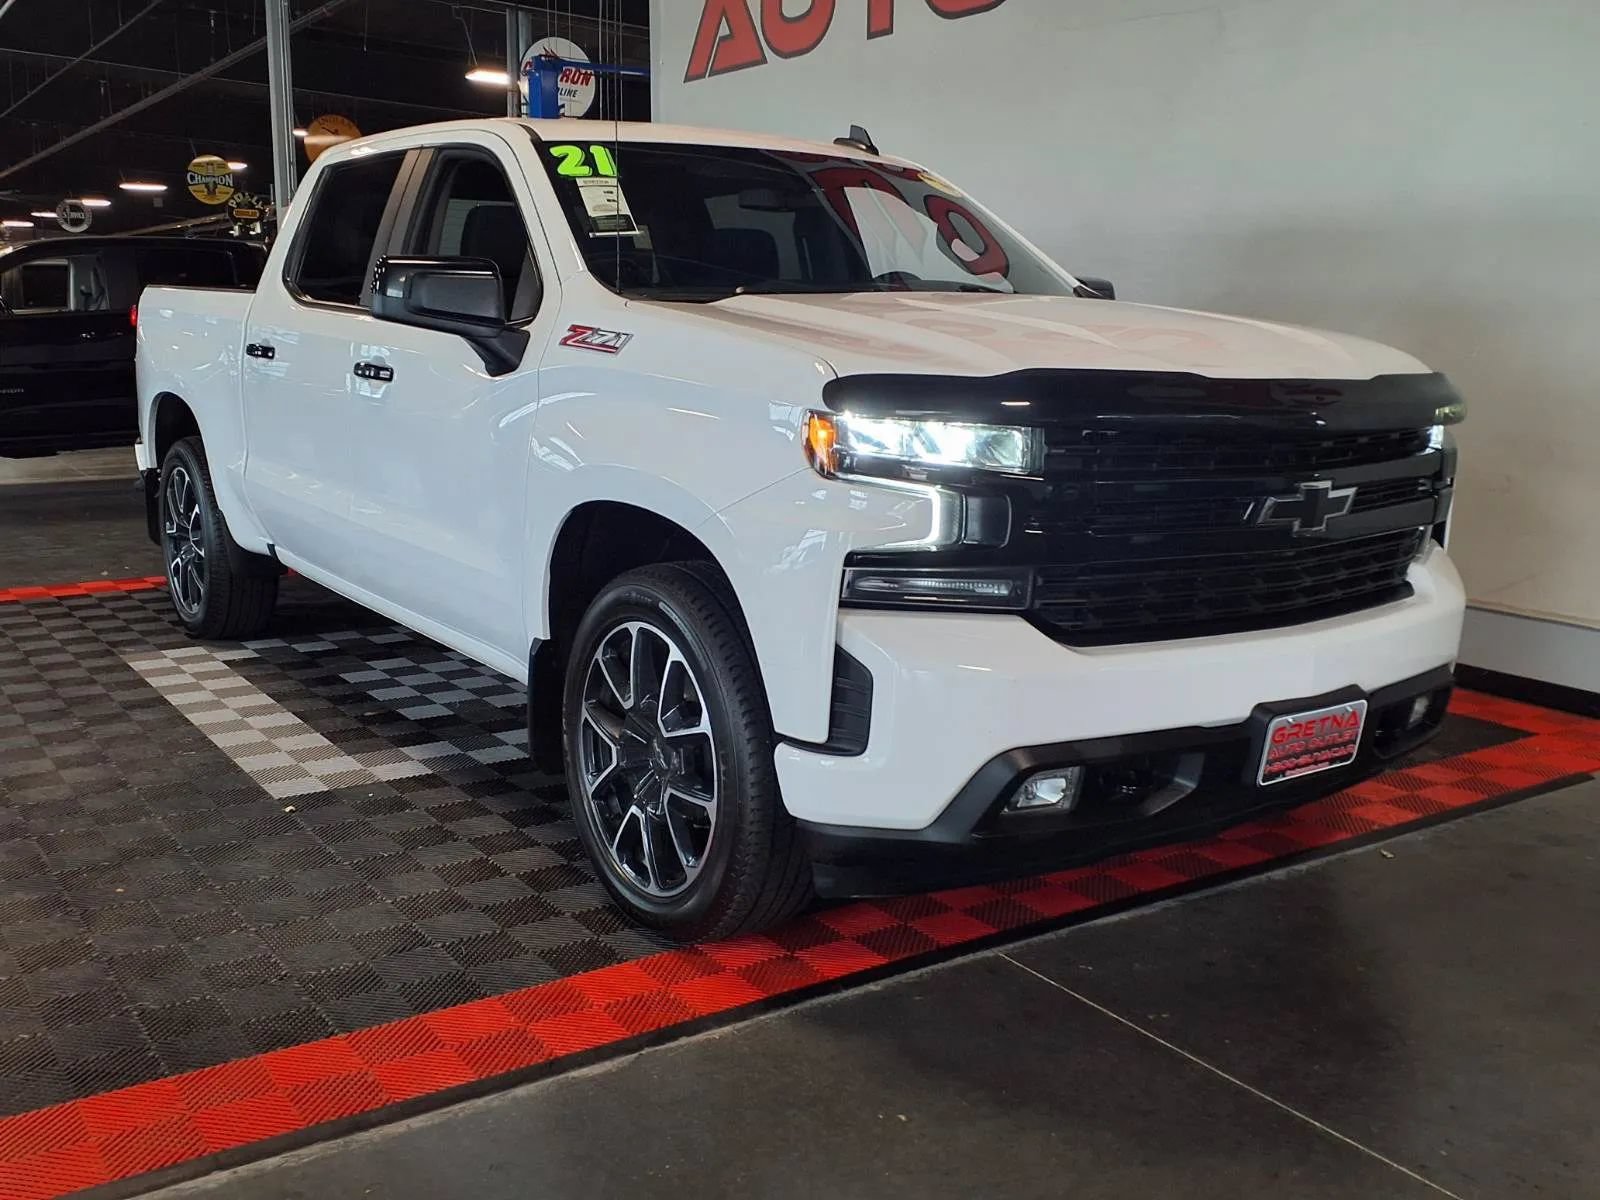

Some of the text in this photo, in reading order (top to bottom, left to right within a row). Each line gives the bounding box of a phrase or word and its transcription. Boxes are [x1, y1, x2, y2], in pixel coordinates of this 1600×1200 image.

[549, 144, 617, 177] 21
[559, 324, 634, 355] Z71
[1272, 711, 1359, 744] GRETNA
